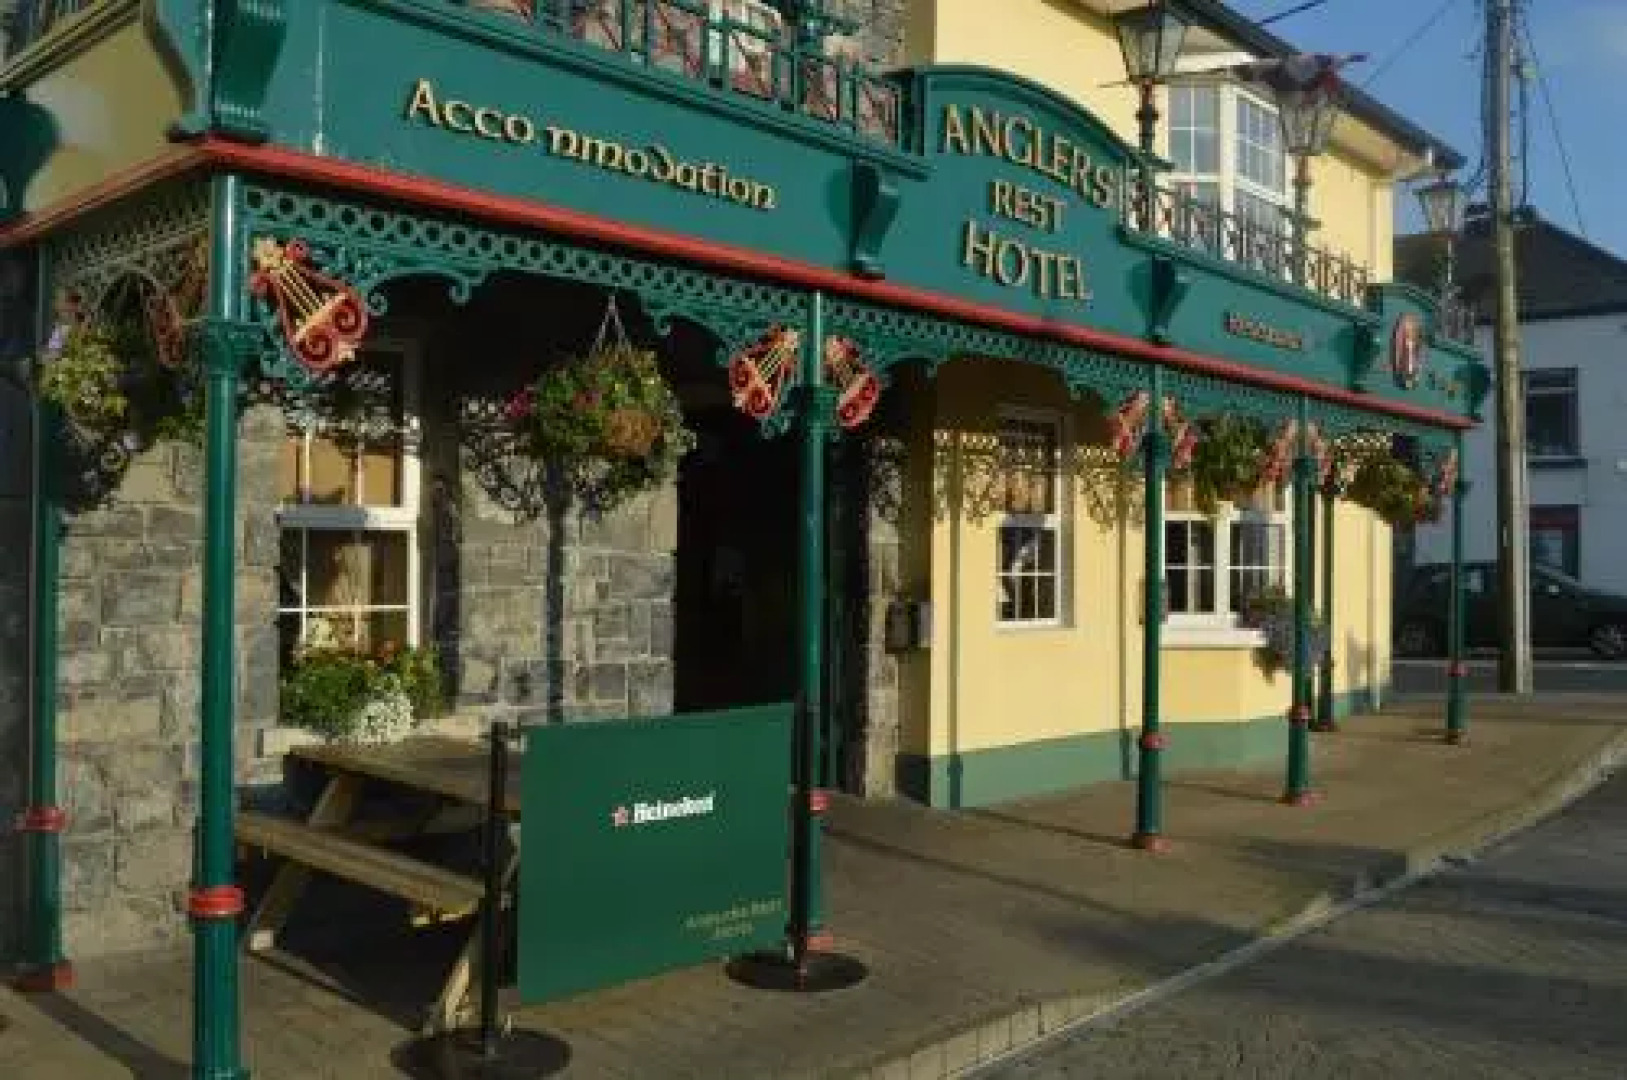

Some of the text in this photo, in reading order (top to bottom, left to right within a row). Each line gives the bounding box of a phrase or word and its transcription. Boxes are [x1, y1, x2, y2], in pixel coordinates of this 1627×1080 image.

[940, 103, 1116, 209] ANGLERS
[991, 180, 1067, 232] REST
[963, 220, 1093, 301] HOTEL
